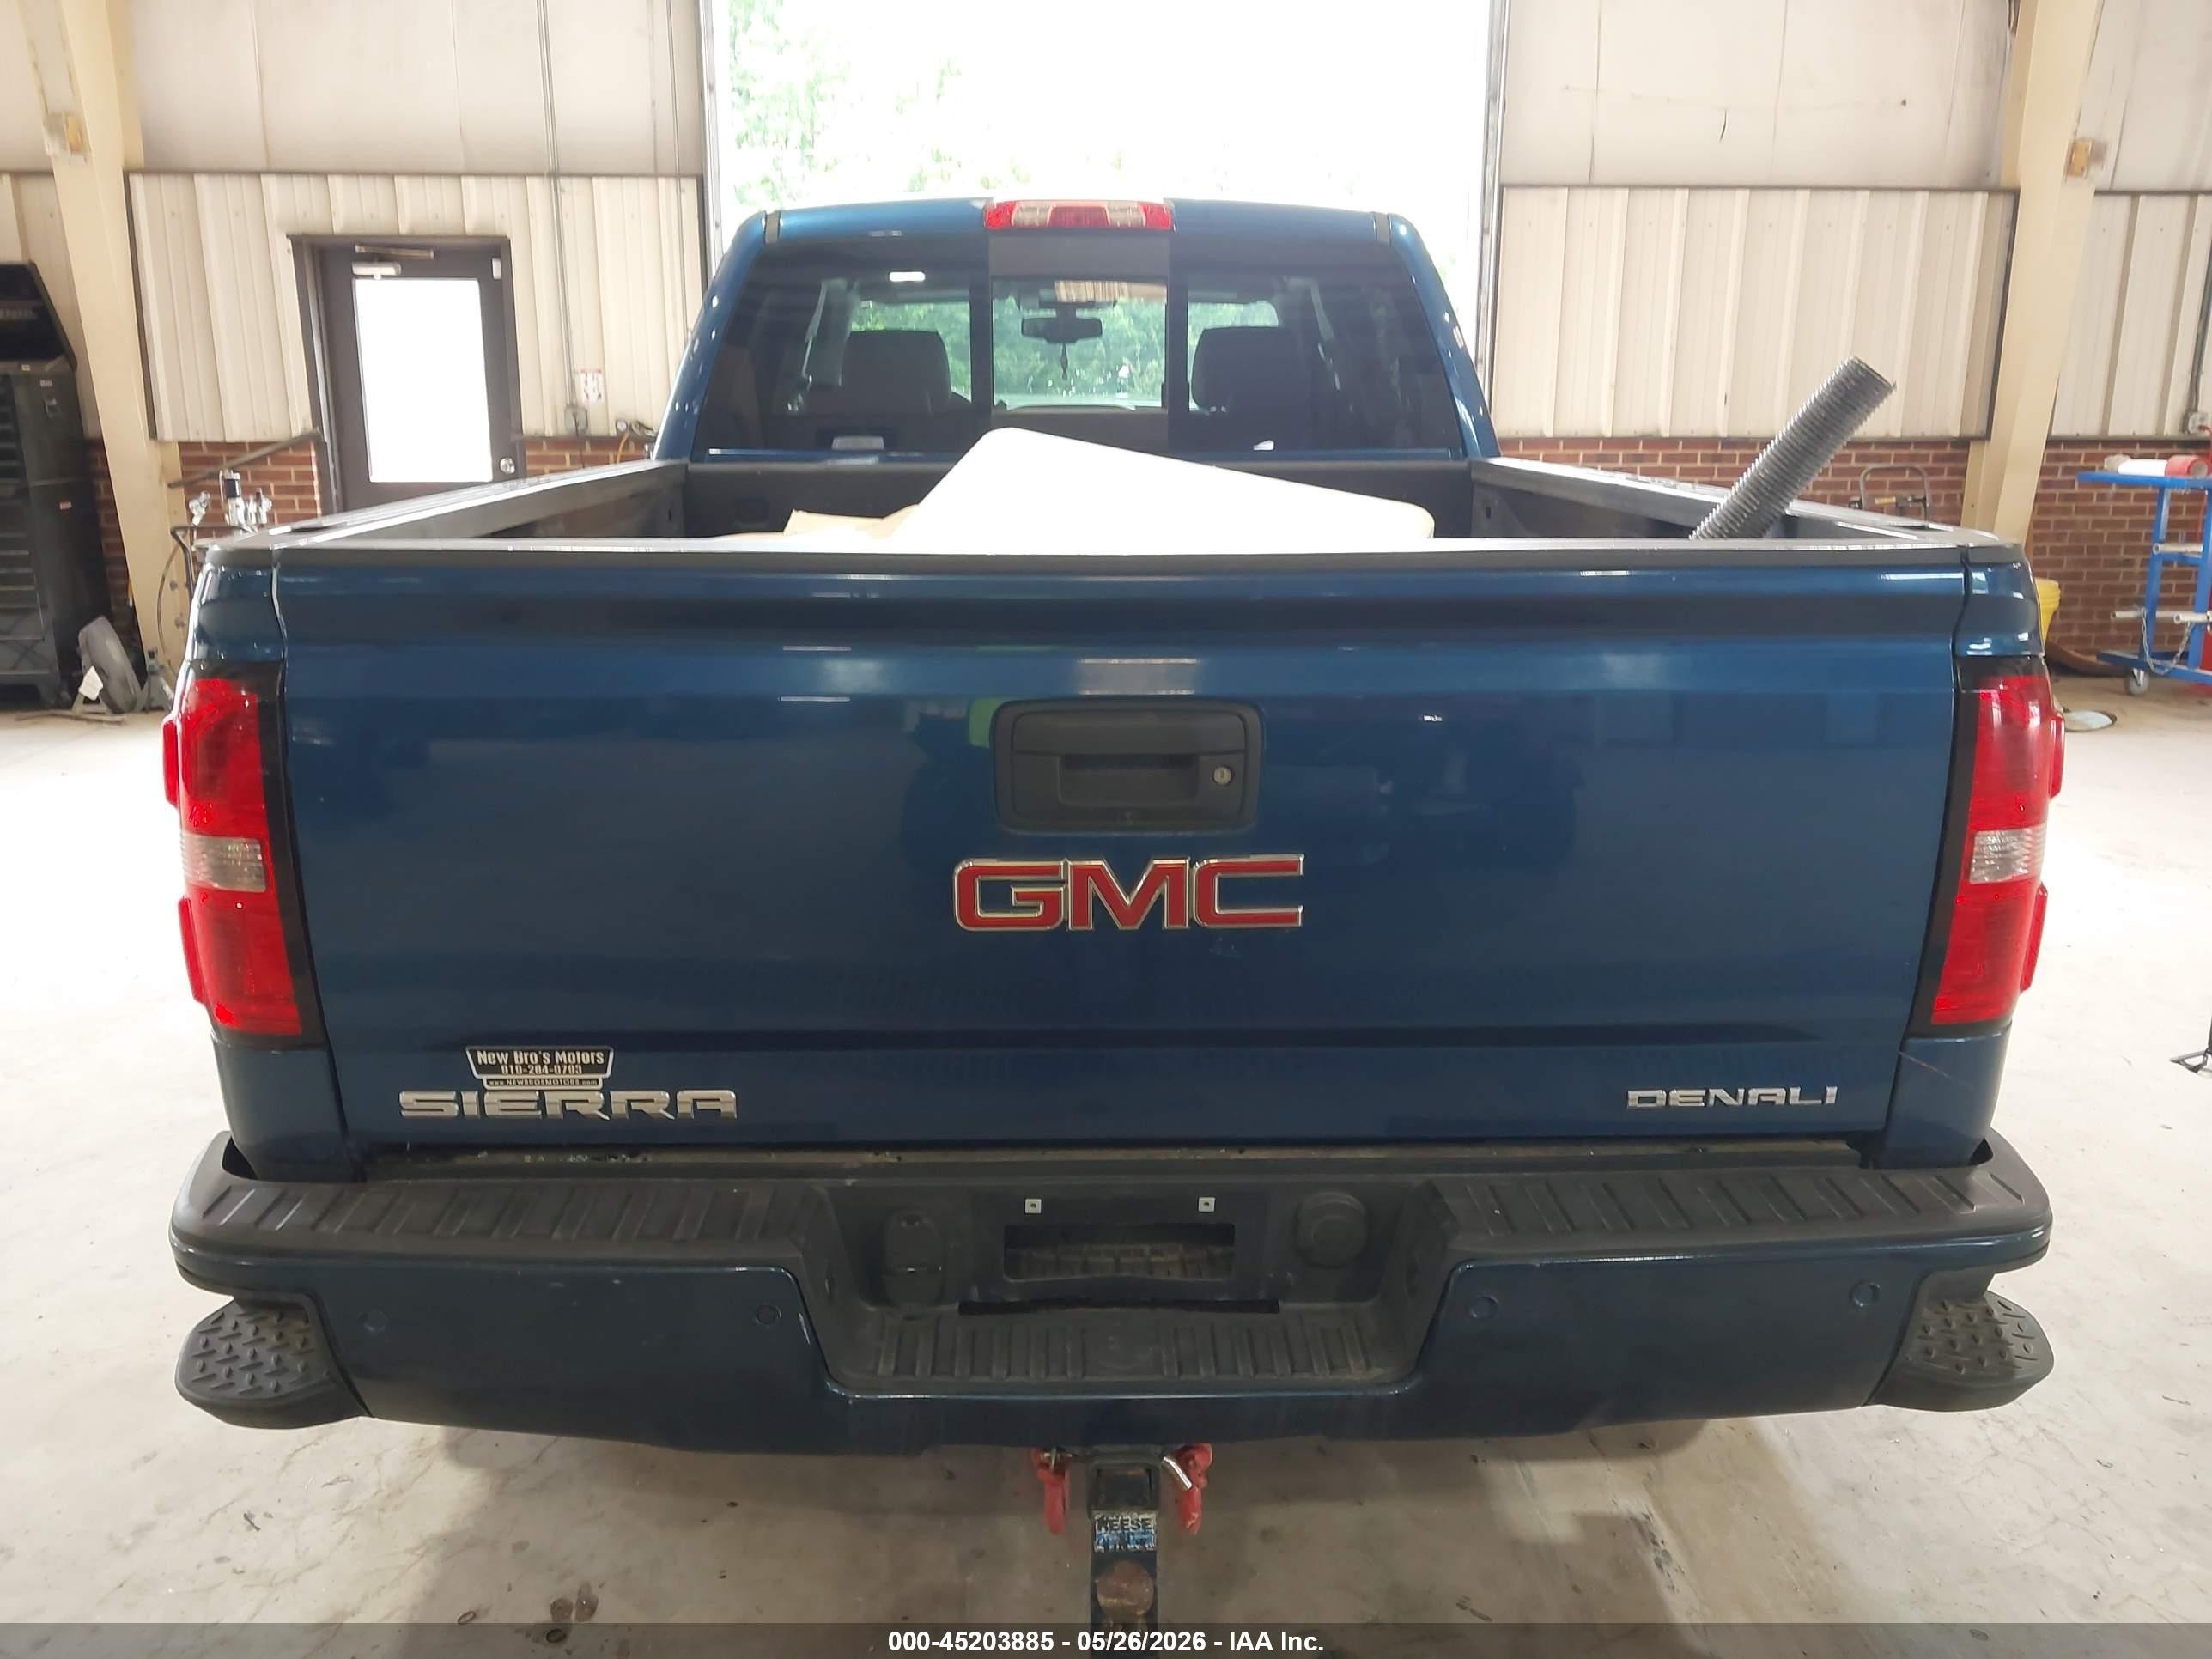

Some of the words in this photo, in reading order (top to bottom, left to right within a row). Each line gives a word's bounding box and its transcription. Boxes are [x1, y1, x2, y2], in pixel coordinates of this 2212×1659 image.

[954, 854, 1304, 930] GMC
[477, 1050, 508, 1065] New
[514, 1050, 550, 1065] Bro's
[556, 1049, 605, 1065] Motors
[399, 1091, 737, 1120] SIERRA
[1626, 1086, 1838, 1107] DENALI
